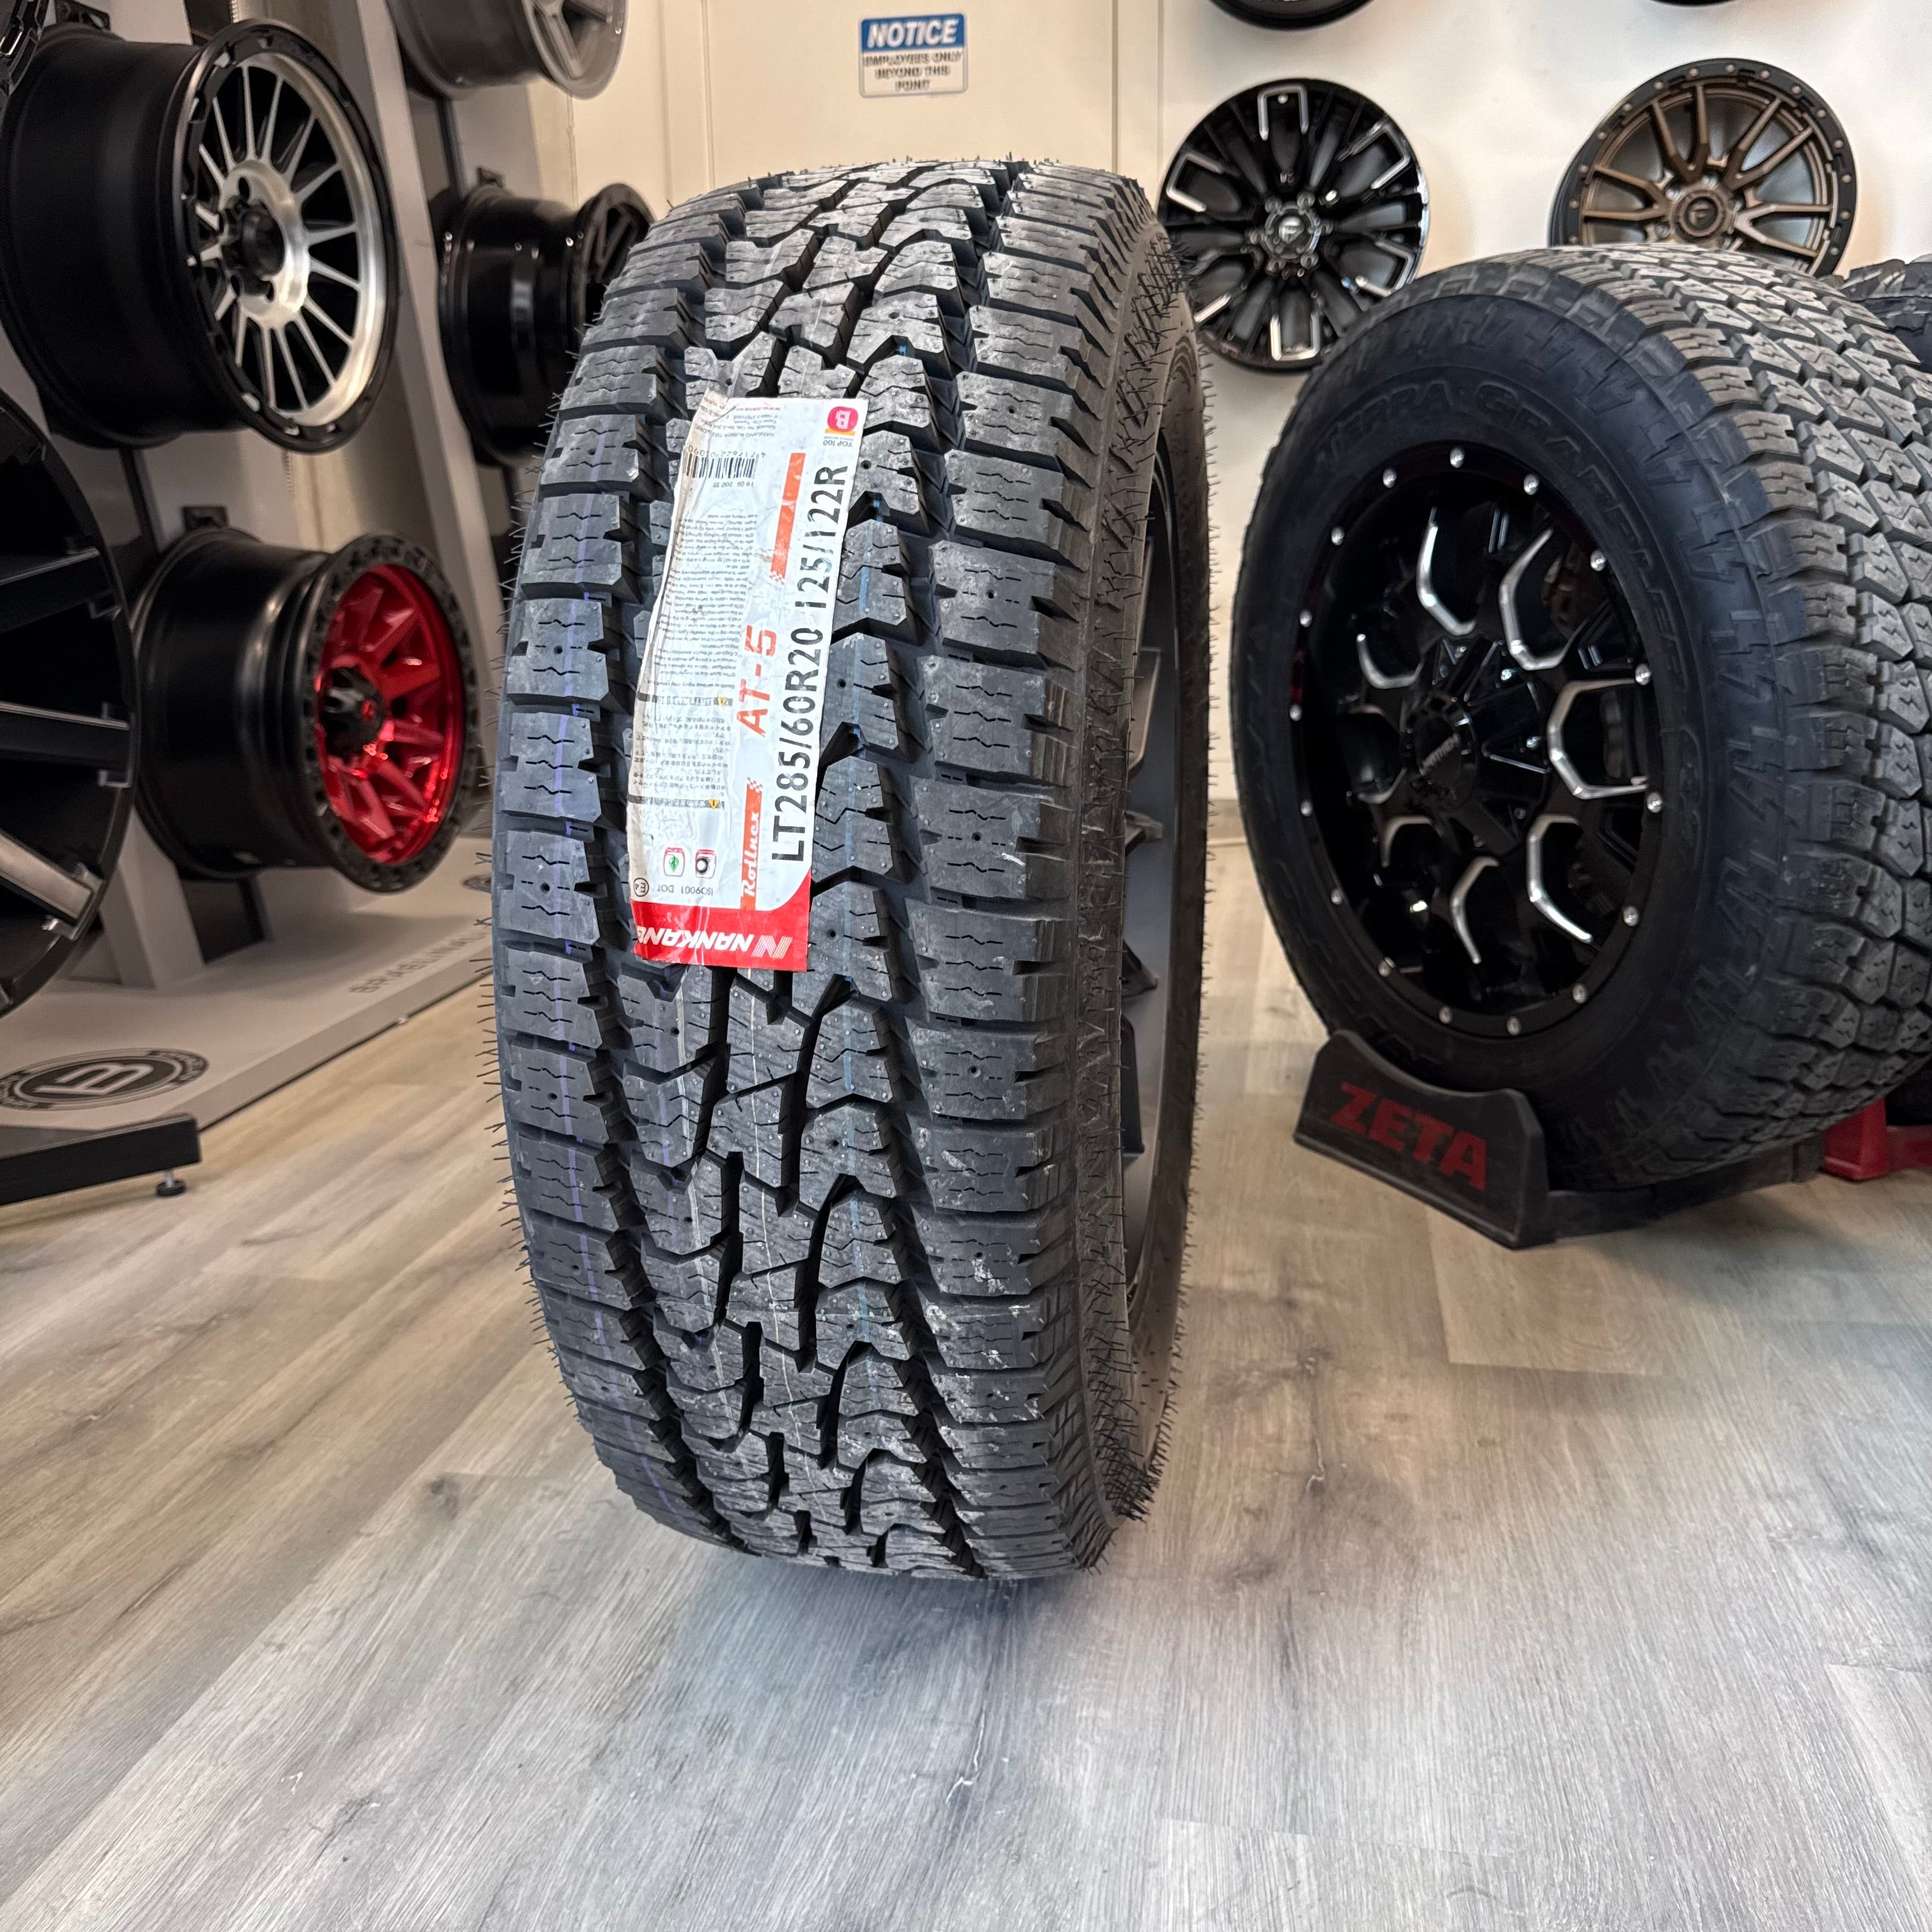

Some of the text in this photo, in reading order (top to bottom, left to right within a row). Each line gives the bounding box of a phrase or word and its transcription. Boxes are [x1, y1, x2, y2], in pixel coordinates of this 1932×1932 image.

[867, 19, 958, 48] NOTICE
[864, 50, 963, 66] EMPLOYEES ONLY
[876, 65, 951, 79] BEYOND THIS
[895, 79, 931, 91] POINT
[794, 465, 848, 609] 125/122R
[736, 624, 777, 737] AT-5
[771, 627, 824, 862] LT285/60R20
[656, 884, 714, 896] ISO9001 DOT
[638, 925, 755, 952] NANKANG
[1331, 1081, 1487, 1193] ZETA
